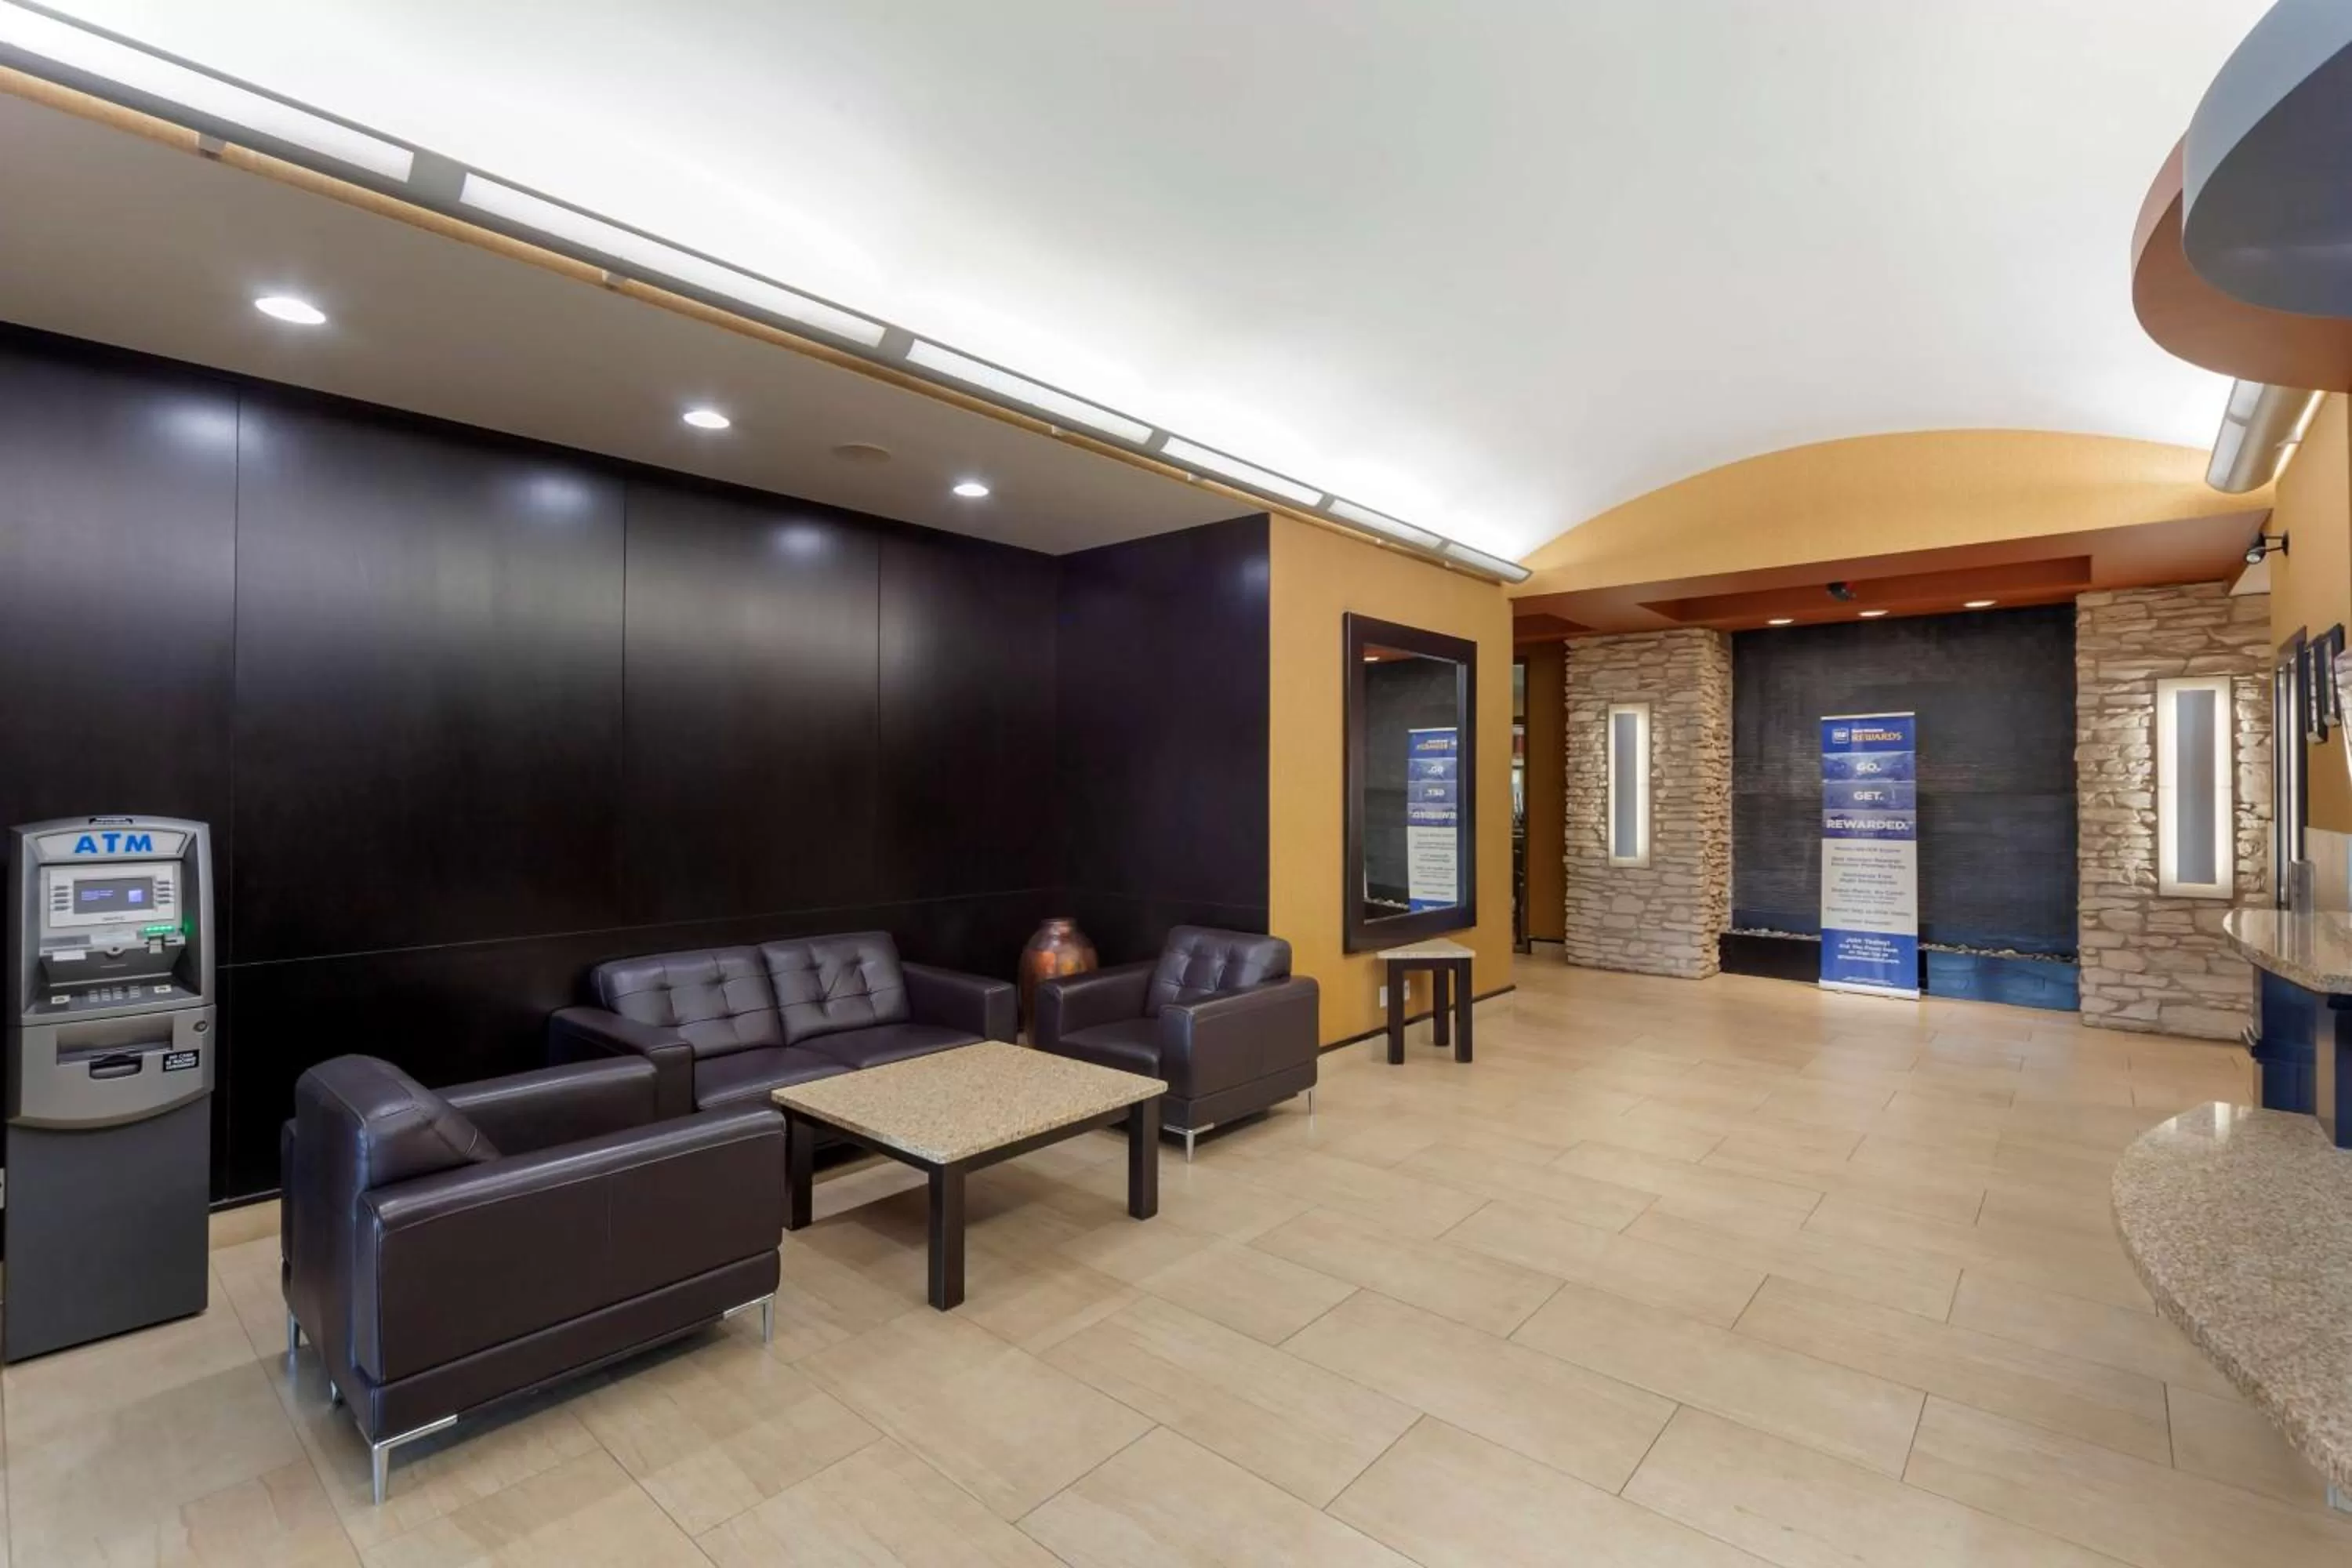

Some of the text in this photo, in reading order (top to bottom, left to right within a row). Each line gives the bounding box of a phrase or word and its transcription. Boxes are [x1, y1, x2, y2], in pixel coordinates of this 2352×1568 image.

[1852, 732, 1902, 742] REWARDS
[1856, 762, 1881, 772] GO.
[1853, 791, 1883, 800] GET.
[1826, 819, 1909, 831] REWARDED.
[74, 833, 152, 853] ATM
